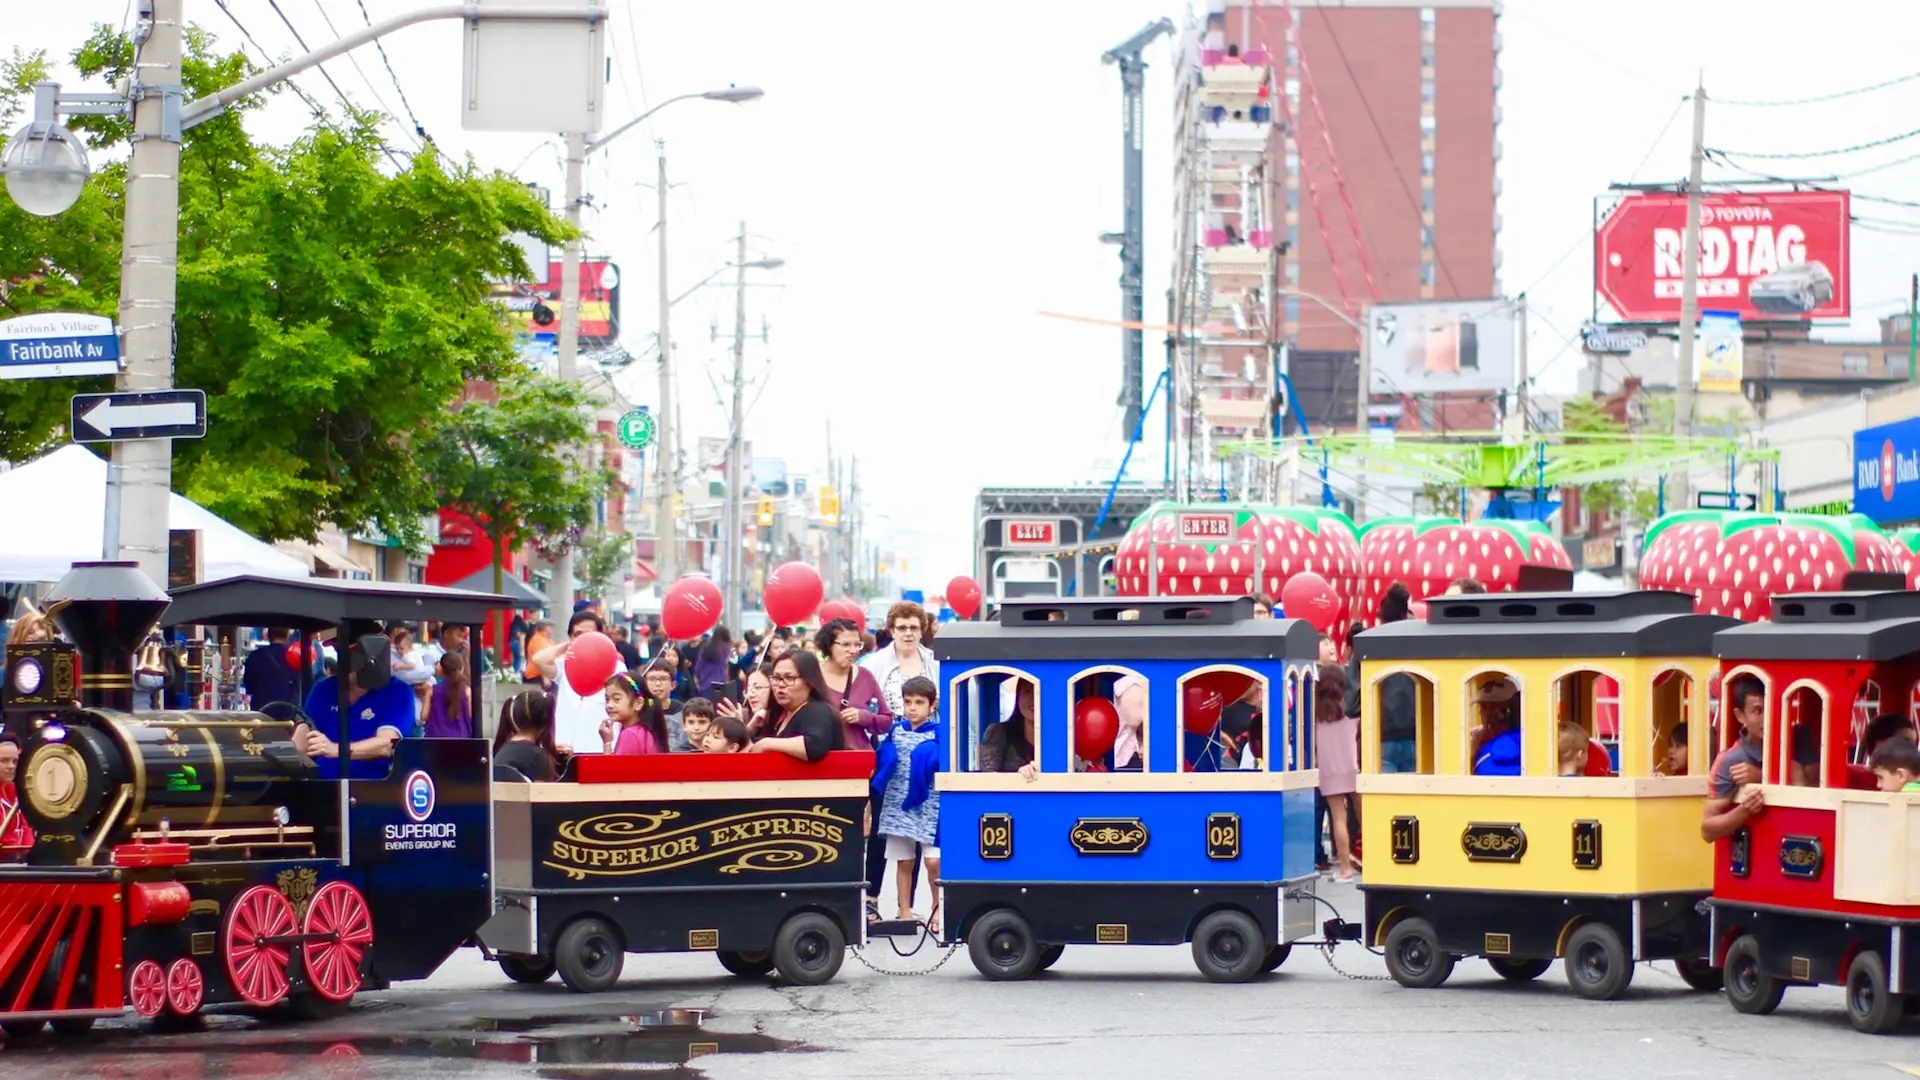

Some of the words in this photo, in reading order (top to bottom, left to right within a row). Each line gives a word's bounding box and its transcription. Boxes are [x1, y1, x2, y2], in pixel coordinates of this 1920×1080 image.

[1715, 206, 1773, 222] TOYOTA
[1730, 224, 1807, 276] TAG
[7, 323, 57, 334] Fairbank
[61, 321, 100, 333] Village
[10, 340, 84, 361] Fairbank
[87, 343, 104, 357] Av
[54, 365, 62, 375] 5
[1858, 457, 1880, 491] BMO
[1896, 447, 1920, 484] Bank
[1016, 523, 1045, 540] EXIT
[1182, 518, 1228, 535] ENTER
[413, 786, 428, 808] S
[385, 823, 456, 840] SUPERIOR
[983, 826, 1008, 847] 02
[1210, 826, 1235, 847] 02
[1394, 830, 1411, 850] 11
[385, 841, 414, 851] EVENTS
[415, 840, 441, 850] GROUP
[442, 839, 457, 849] INC.
[553, 836, 700, 867] SUPERIOR
[711, 817, 843, 847] EXPRESS
[1576, 834, 1593, 854] 11
